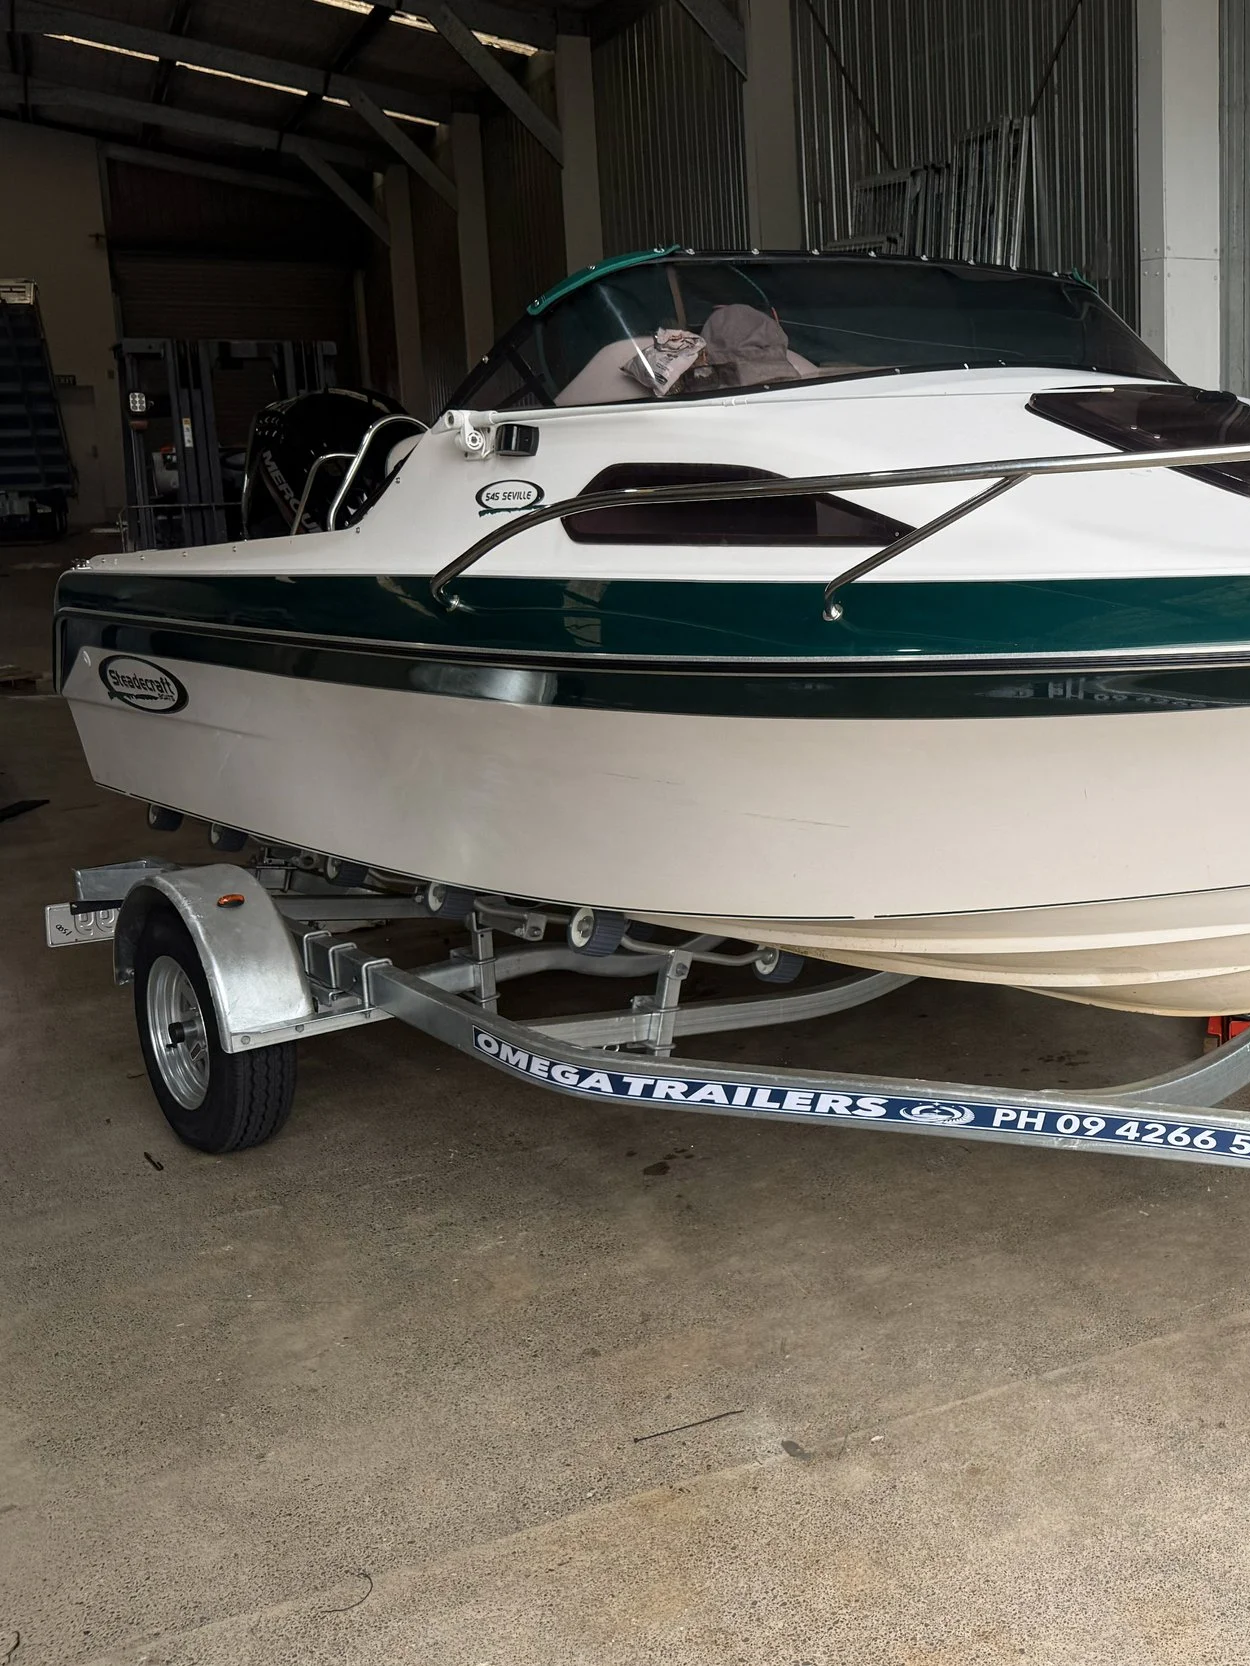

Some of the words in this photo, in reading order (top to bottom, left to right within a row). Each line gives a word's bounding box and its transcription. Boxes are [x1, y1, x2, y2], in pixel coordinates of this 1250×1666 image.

[262, 449, 323, 534] MERCU
[502, 490, 533, 501] SEVILLE
[109, 669, 175, 695] Steadecraft
[477, 1032, 614, 1094] OMEGA
[622, 1076, 889, 1118] TRAILERS
[992, 1107, 1047, 1132] PH
[1056, 1113, 1106, 1138] 09
[1115, 1120, 1217, 1150] 4266
